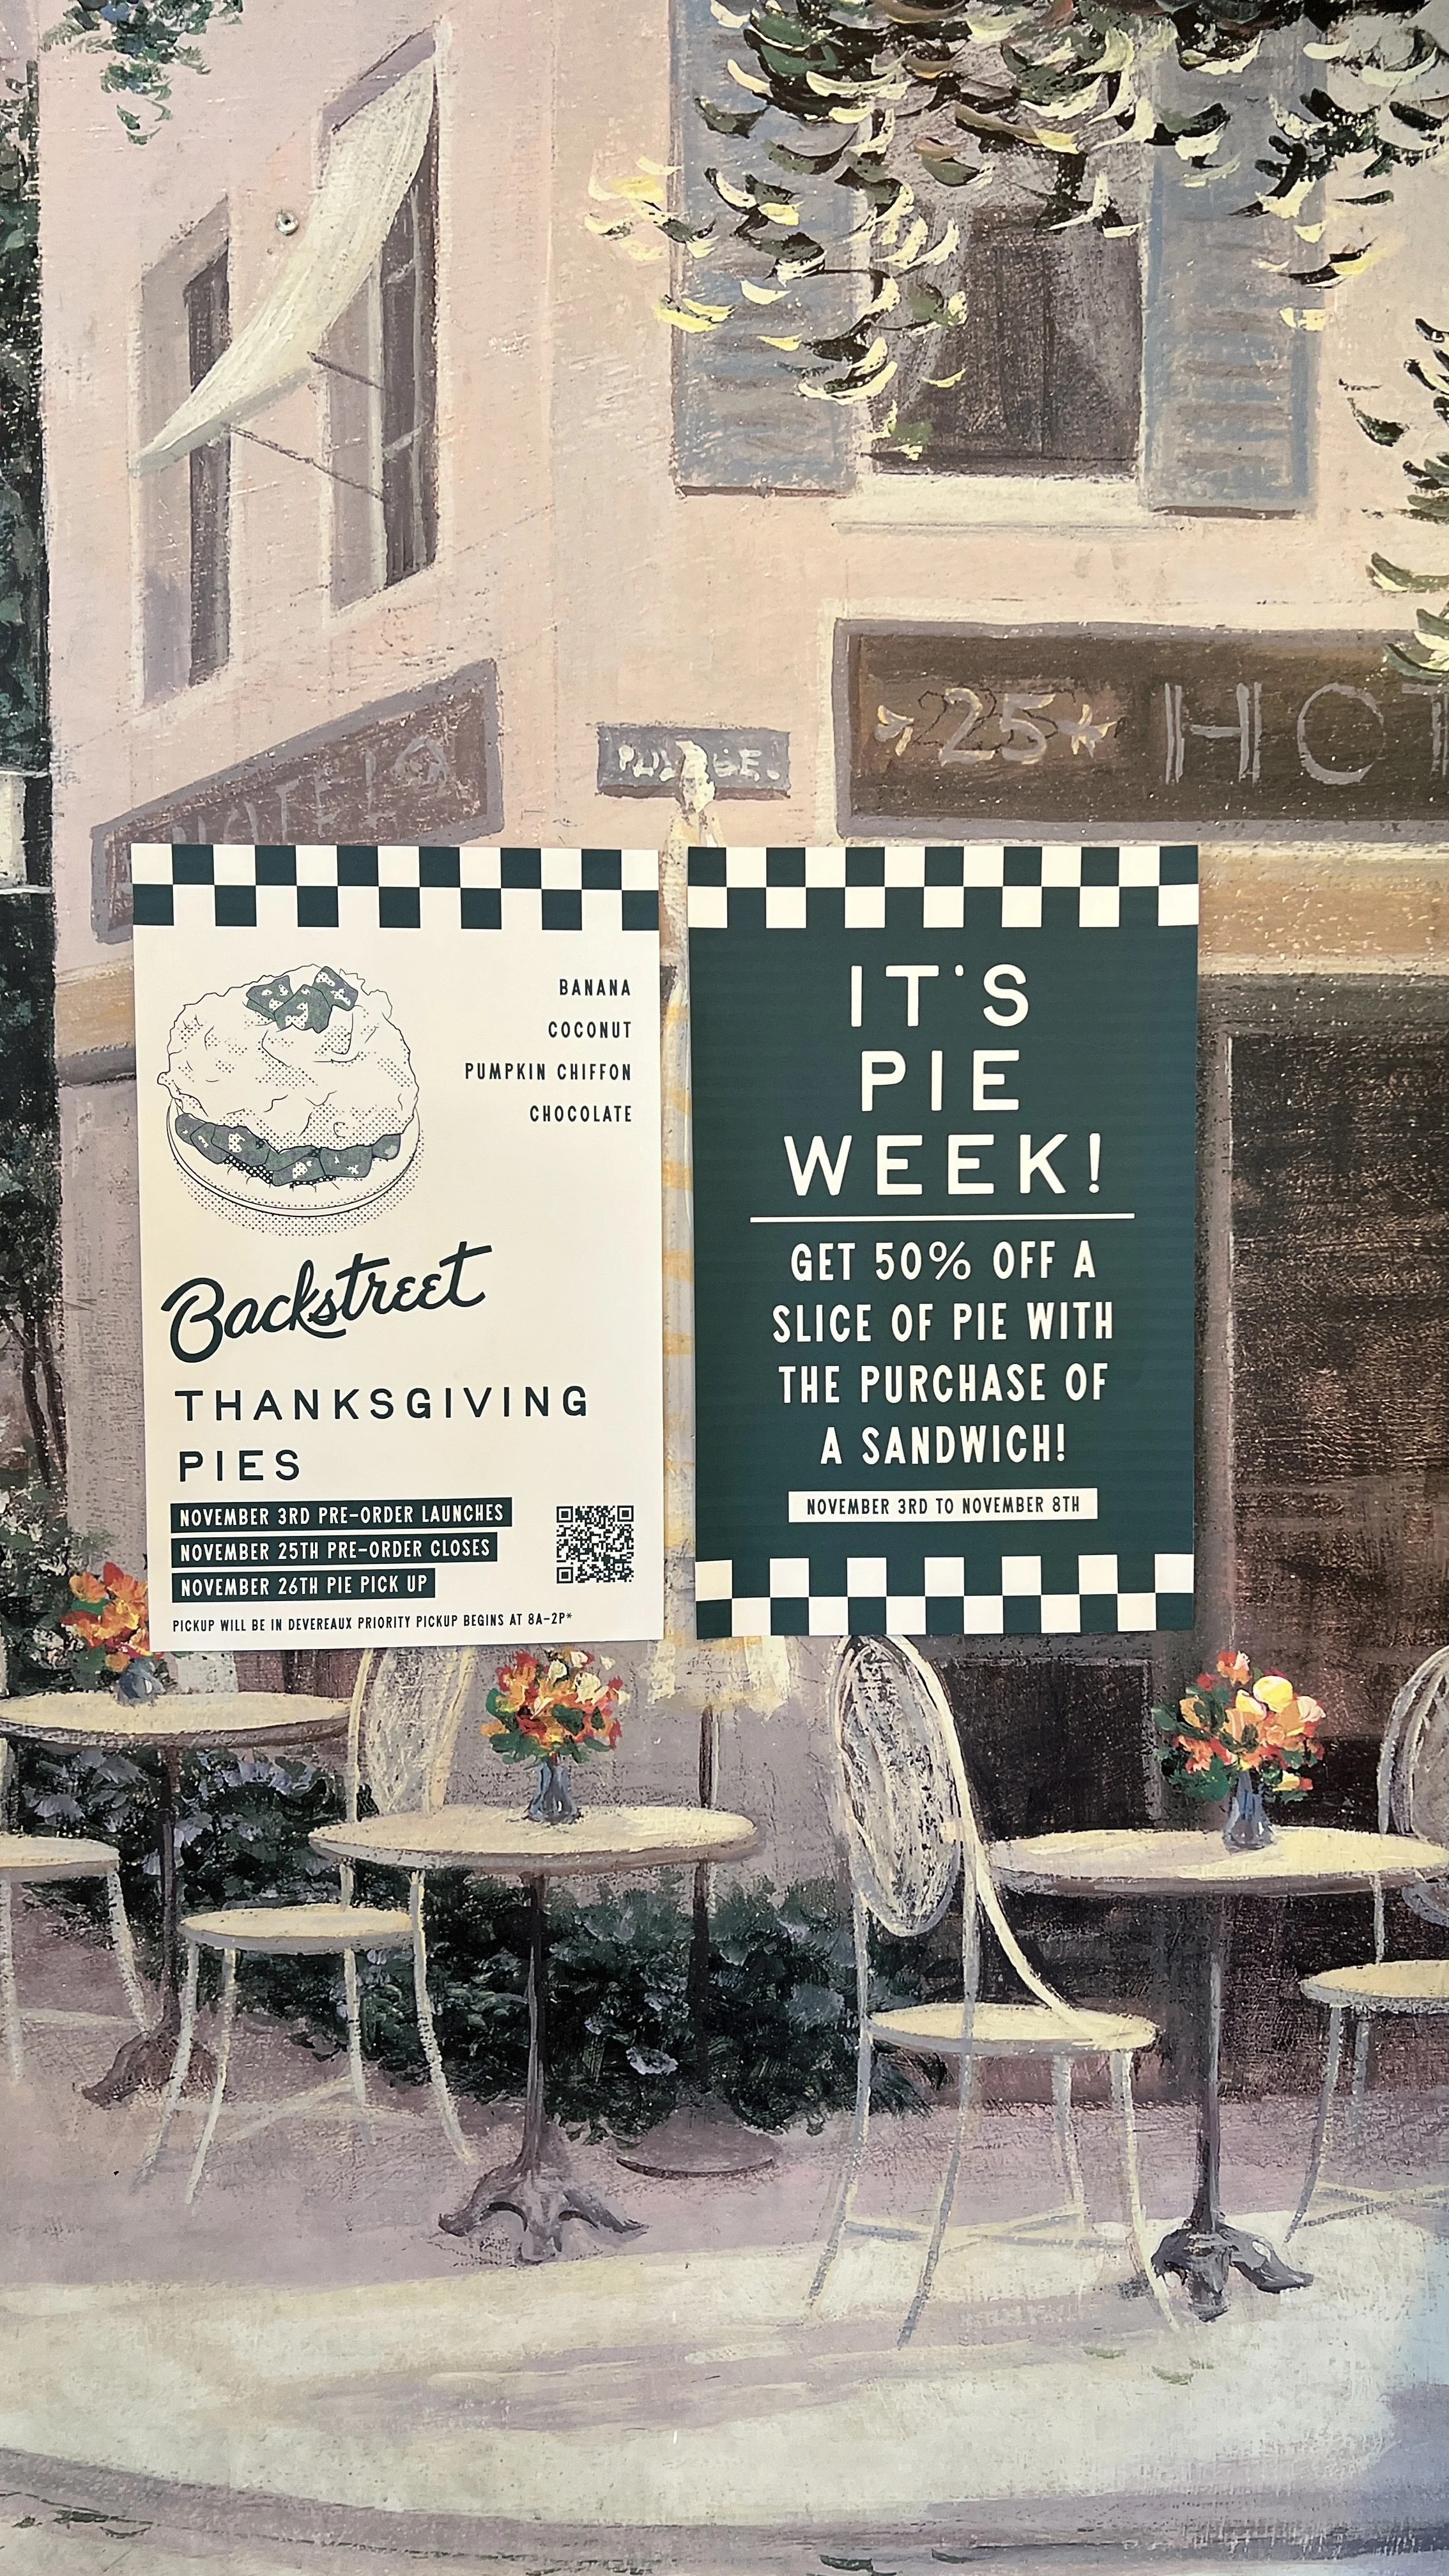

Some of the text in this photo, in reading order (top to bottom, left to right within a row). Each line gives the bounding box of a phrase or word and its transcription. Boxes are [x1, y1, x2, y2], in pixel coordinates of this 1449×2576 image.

[938, 686, 1048, 767] 25
[559, 978, 631, 997] BANANA
[851, 964, 1029, 1027] IT'S
[548, 1021, 631, 1039] COCONUT
[465, 1062, 631, 1081] PUMPKIN CHIFFON
[861, 1050, 1020, 1112] PIE
[530, 1105, 631, 1123] CHOCOLATE
[783, 1133, 1101, 1196] WEEK!
[791, 1240, 1096, 1282] GET 50% OFF A
[160, 1241, 493, 1363] Backstreet
[772, 1301, 1112, 1343] SLICE OF PIE WITH
[778, 1363, 1108, 1404] THE PURCHASE OF
[174, 1385, 586, 1422] THANKSGIVING
[820, 1423, 1065, 1465] A SANDWICH!
[179, 1449, 300, 1482] PIES
[180, 1503, 503, 1527] NOVEMBER 3RD PRE-ORDER LAUNCHES
[807, 1496, 1079, 1515] NOVEMBER 3RD TO NOVEMBER 8TH
[181, 1538, 489, 1562] NOVEMBER 25TH PRE-ORDER CLOSES
[181, 1574, 427, 1597] NOVEMBER 26TH PIE PICK UP
[172, 1620, 215, 1632] PICKUP
[220, 1619, 247, 1632] WILL
[252, 1619, 265, 1631] BE
[271, 1618, 282, 1631] IN
[288, 1617, 352, 1630] DEVEREAUX
[358, 1616, 411, 1629] PRIORITY
[416, 1614, 458, 1628] PICKUP
[463, 1614, 504, 1627] BEGINS
[509, 1613, 523, 1626] AT
